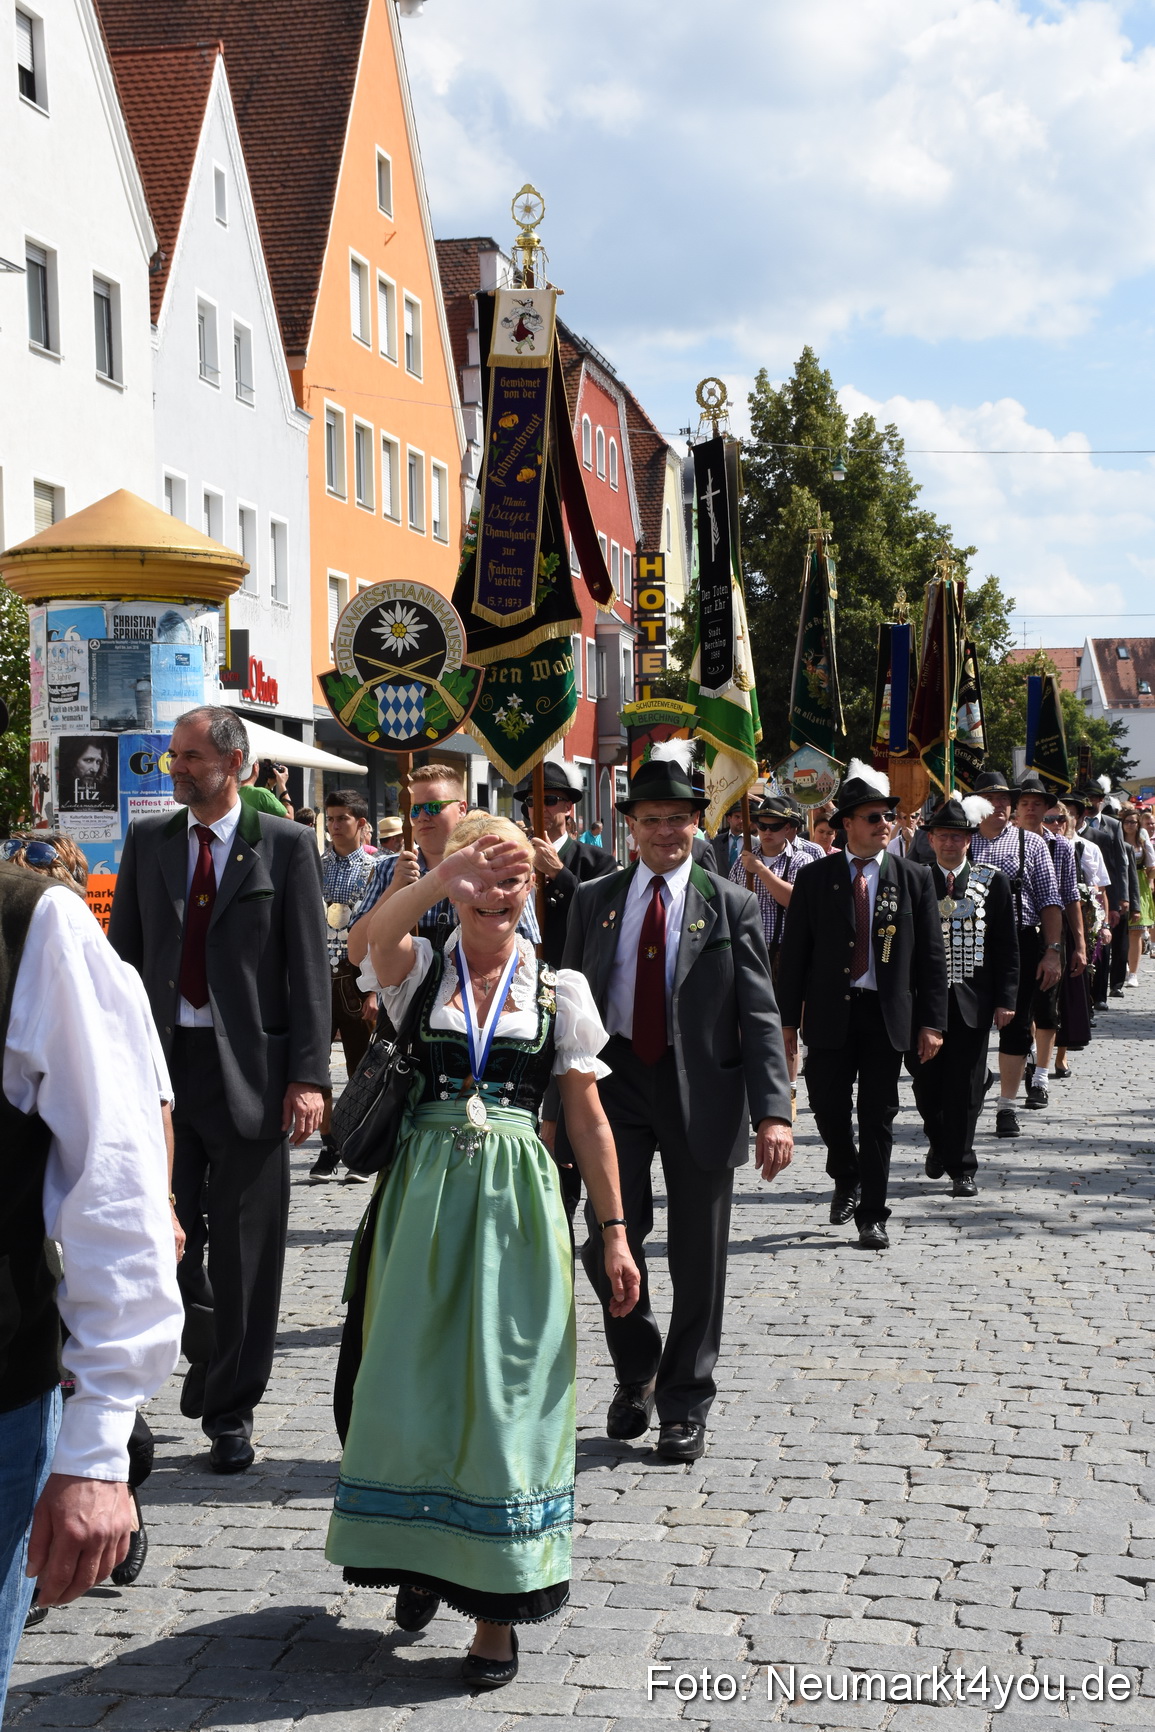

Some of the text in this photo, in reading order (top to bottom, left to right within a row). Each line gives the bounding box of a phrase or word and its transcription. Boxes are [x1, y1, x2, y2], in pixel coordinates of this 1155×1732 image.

[500, 377, 541, 388] Gewidmet
[503, 388, 537, 399] von der
[488, 412, 543, 487] Fahnenbraut
[502, 496, 527, 507] Maria
[487, 503, 535, 526] Bayer
[502, 547, 517, 556] zur
[494, 577, 522, 587] weihe
[701, 584, 729, 602] Den Toten
[113, 614, 157, 628] CHRISTIAN
[383, 583, 462, 671] THANNHAUSEN
[113, 627, 154, 639] SPRINGER
[708, 626, 721, 638] Stadt
[704, 638, 727, 651] Berching
[635, 700, 684, 711] SCHÜTZENVEREIN
[637, 712, 680, 725] BERCHING
[73, 777, 100, 804] fitz
[129, 799, 162, 807] Hoffest
